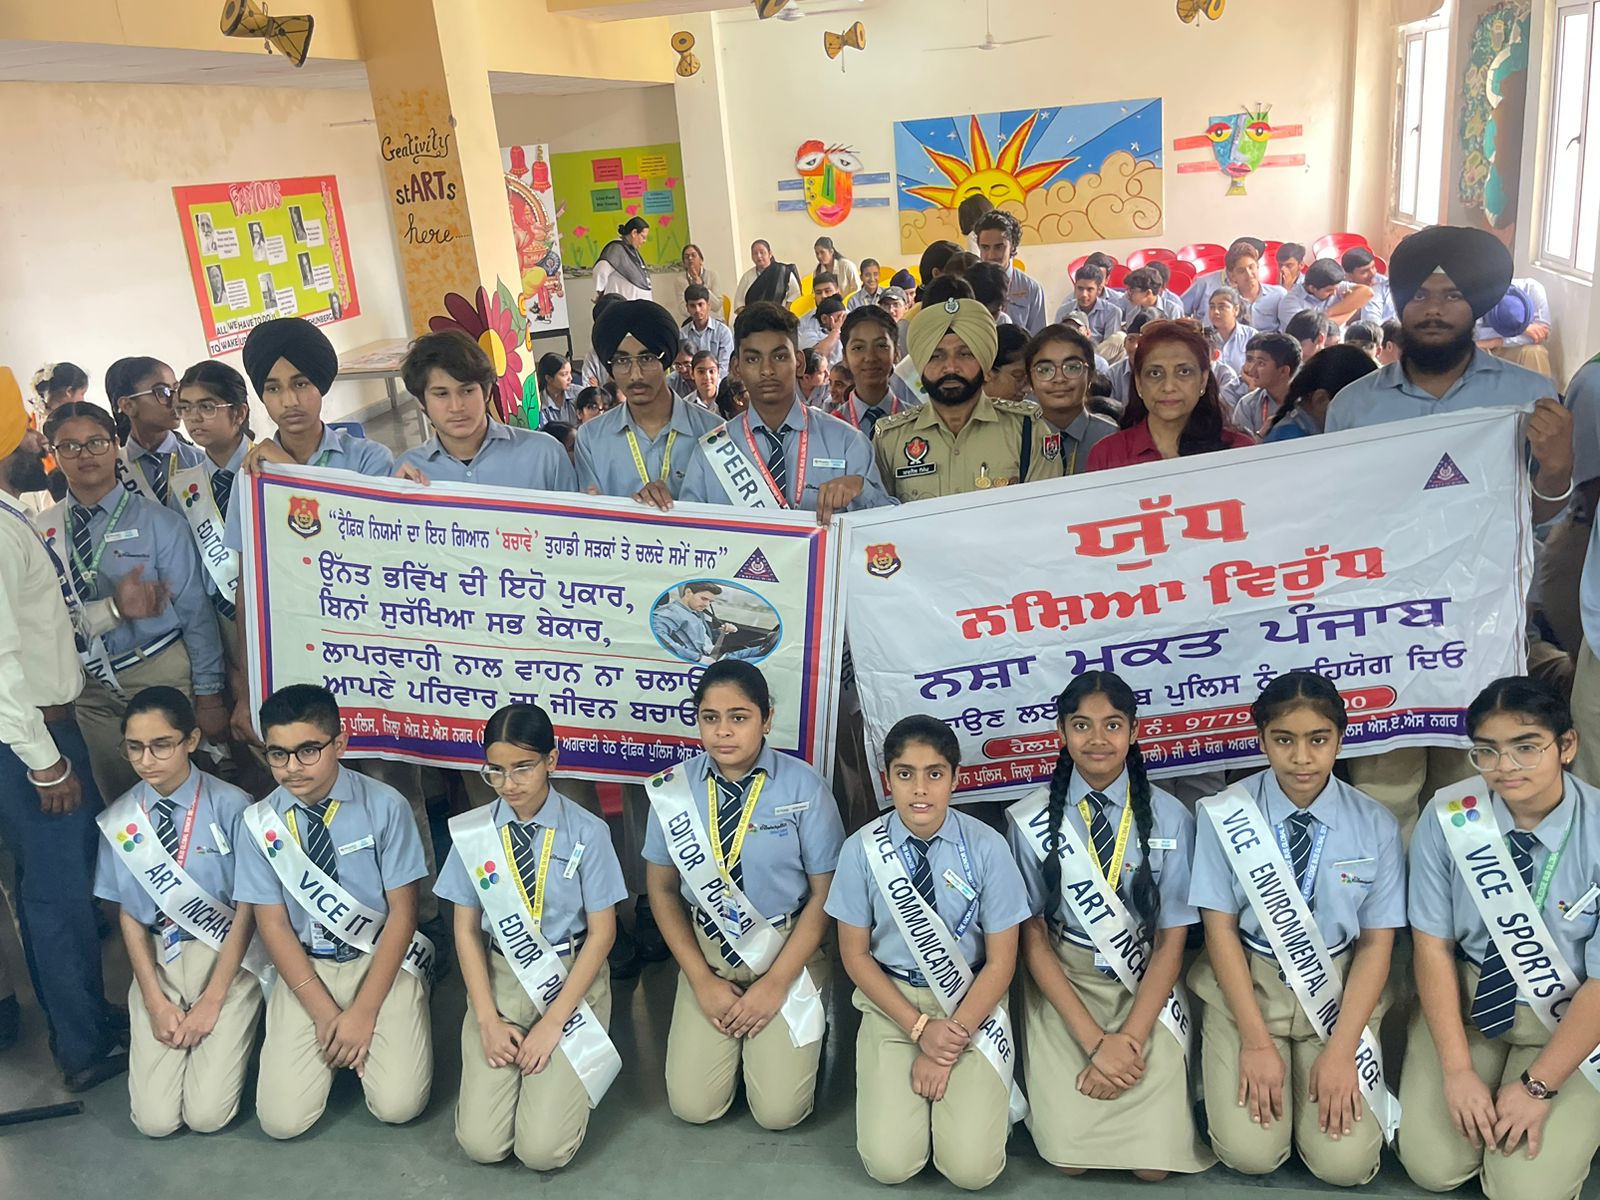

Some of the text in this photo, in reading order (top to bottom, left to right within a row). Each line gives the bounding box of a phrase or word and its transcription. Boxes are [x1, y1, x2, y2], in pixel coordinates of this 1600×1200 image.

[381, 127, 450, 164] Creativity
[229, 181, 282, 217] FAMOUS
[396, 171, 456, 205] stARTs
[220, 338, 239, 350] WAKE
[716, 441, 758, 501] PEER
[197, 518, 230, 567] EDITOR
[408, 525, 420, 543] ਦਾ
[425, 520, 447, 546] ਇਹ
[452, 522, 489, 549] ਗਿਆਨ
[545, 531, 580, 559] ਤੁਹਾਡੀ
[621, 536, 631, 561] ਤੇ
[636, 539, 664, 563] ਚਲਦੇ
[1067, 494, 1248, 571] ਯੁੱਧ
[383, 560, 447, 593] ਭਵਿੱਖ
[459, 566, 488, 597] ਦੀ
[499, 568, 546, 601] ਇਹੋ
[558, 581, 634, 614] ਪੁਕਾਰ,
[1204, 544, 1388, 605] ਵਿਰੁੱਧ
[319, 587, 611, 648] ਬਿਨਾਂ ਸੁਰੱਖਿਆ ਸਭ ਬੇਕਾਰ,
[322, 641, 442, 673] ਲਾਪਰਵਾਹੀ
[453, 655, 503, 679] ਨਾਲ
[515, 660, 583, 684] ਵਾਹਨ
[594, 665, 624, 687] ਨਾ
[914, 656, 1036, 700] ਨਸ਼ਾ
[1259, 596, 1452, 644] ਪੰਜਾਬ
[322, 671, 396, 699] ਆਪਣੇ
[408, 676, 498, 710] ਪਰਿਵਾਰ
[550, 687, 618, 720] ਜੀਵਨ
[1164, 674, 1241, 707] ਪੁਲਿਸ
[1290, 652, 1393, 681] ਹਿਯੋਗ
[452, 727, 474, 744] ਨਗਰ
[602, 734, 617, 755] ਹੇਠ
[1171, 741, 1184, 759] ਜੀ
[1188, 739, 1201, 757] ਦੀ
[1228, 737, 1259, 751] ਅਗਵਾ
[1430, 714, 1458, 727] ਨਗਰ
[668, 810, 706, 871] EDITOR
[1028, 806, 1075, 861] VICE
[1067, 879, 1116, 924] ART
[144, 862, 233, 944] ART INCHAR
[299, 870, 373, 936] VICE IT
[871, 824, 897, 865] VICE
[887, 876, 965, 999] COMMUNICATION
[1221, 808, 1261, 856] VICE
[1248, 861, 1331, 998] ENVIRONMENTAL
[1465, 843, 1514, 900] VICE
[1496, 912, 1566, 999] SPORTS
[498, 912, 543, 970] EDITOR
